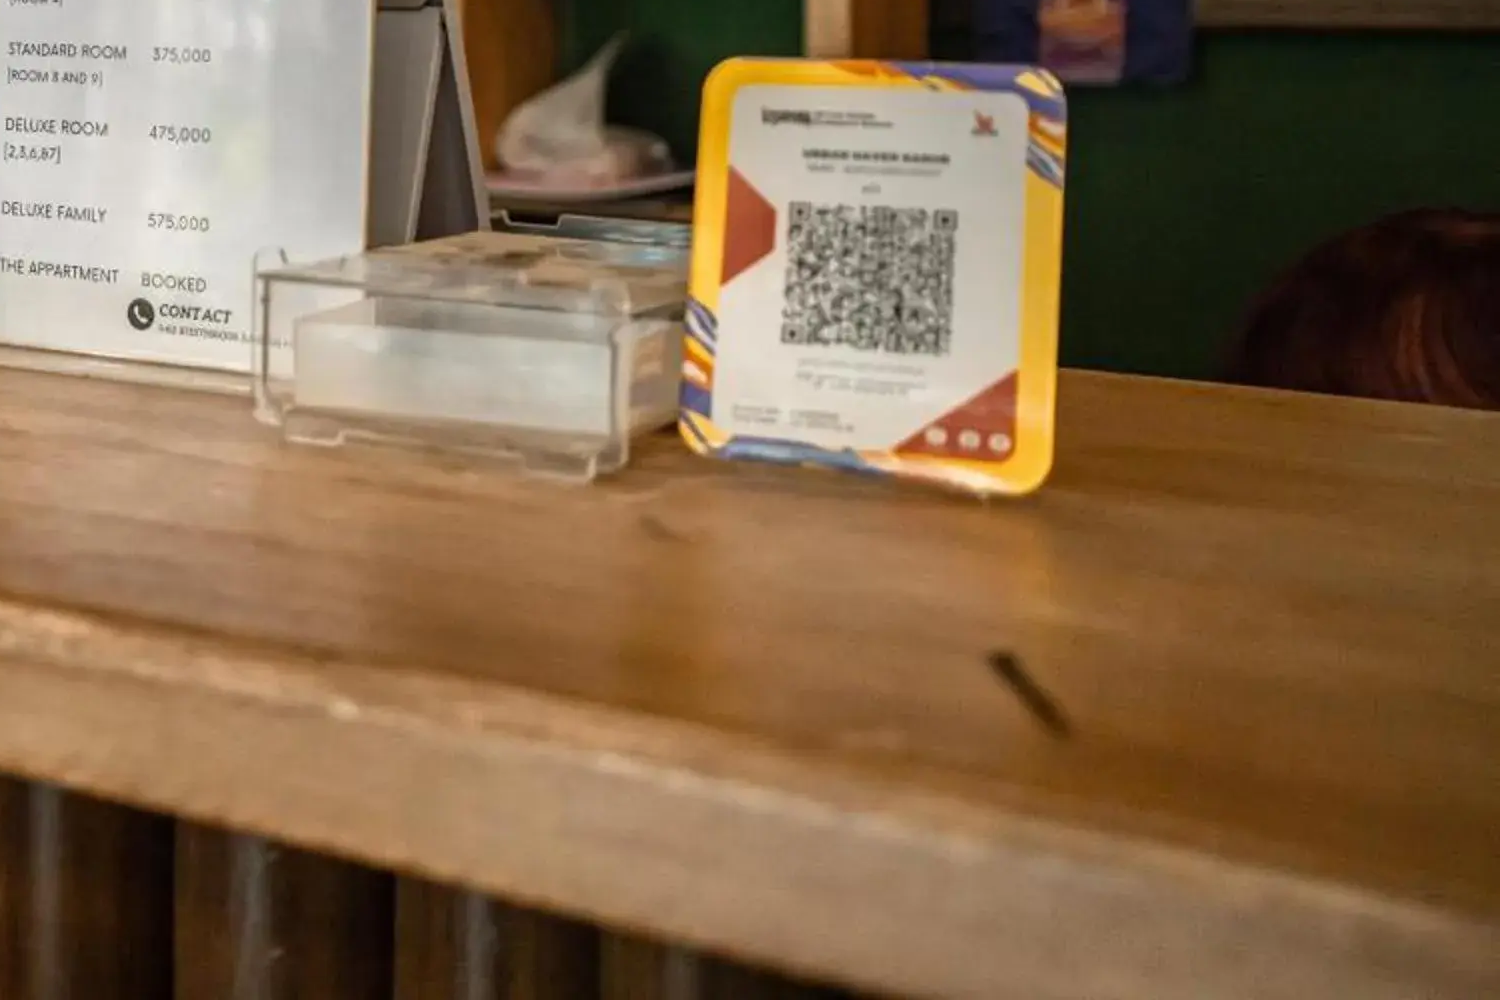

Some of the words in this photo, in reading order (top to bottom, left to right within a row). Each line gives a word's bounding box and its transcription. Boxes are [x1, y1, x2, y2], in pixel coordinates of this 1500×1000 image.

[8, 42, 77, 58] STANDARD
[81, 44, 127, 60] ROOM
[152, 47, 211, 64] 375,000
[62, 69, 87, 84] AND
[5, 117, 56, 134] DELUXE
[61, 119, 109, 136] ROOM
[149, 125, 211, 145] 475,000
[1, 201, 52, 219] DELUXE
[57, 205, 107, 223] FAMILY
[147, 213, 210, 232] 575,000
[0, 257, 24, 275] THE
[28, 260, 120, 284] APPARTMENT
[141, 272, 207, 293] BOOKED
[159, 303, 232, 324] CONTACT
